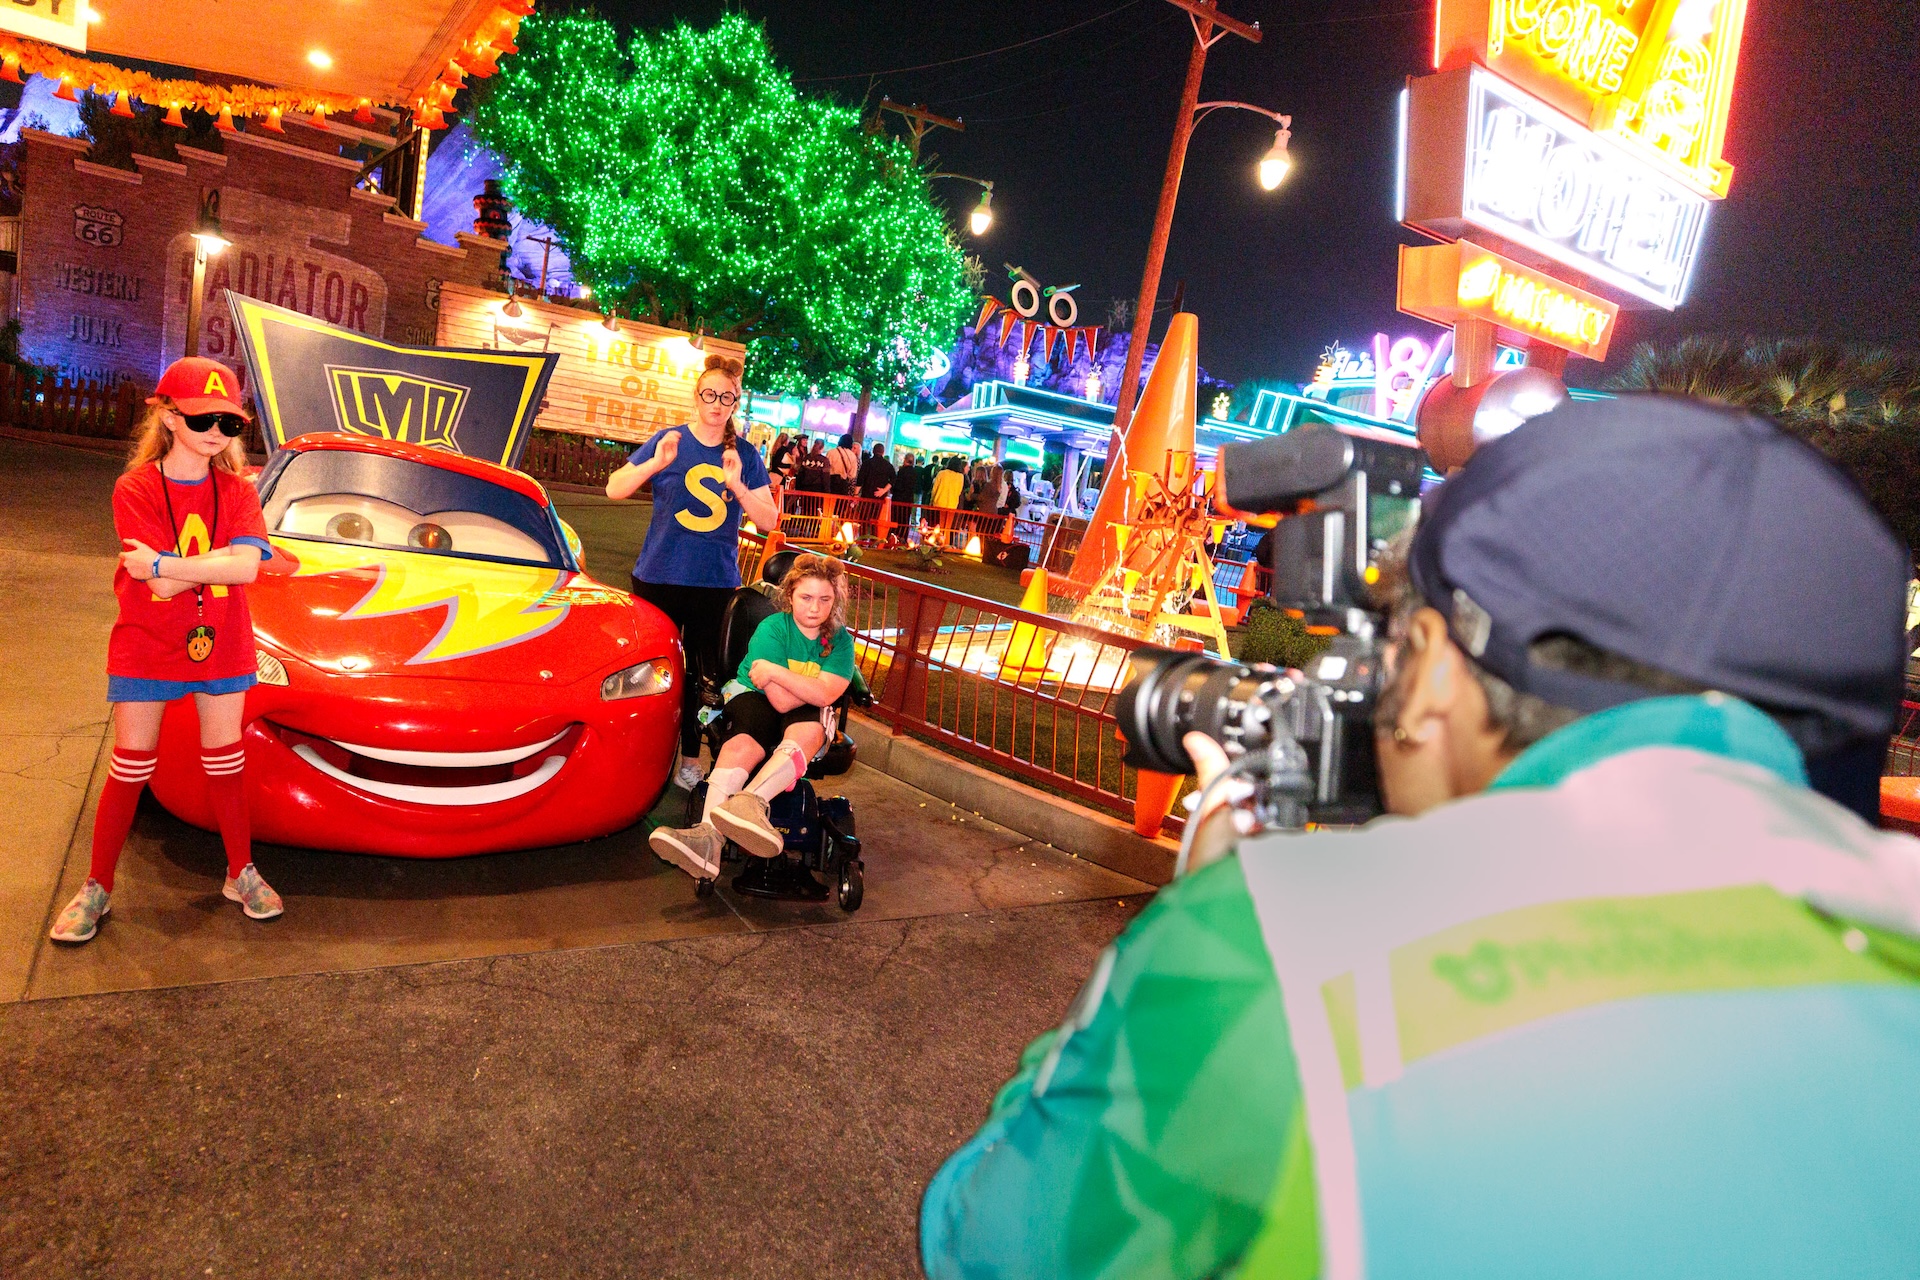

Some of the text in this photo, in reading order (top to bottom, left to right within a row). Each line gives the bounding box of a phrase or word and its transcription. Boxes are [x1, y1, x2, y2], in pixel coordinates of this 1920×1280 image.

[82, 208, 117, 223] ROUTE
[81, 223, 114, 245] 66
[54, 262, 141, 302] WESTERN
[66, 314, 122, 348] JUNK
[203, 371, 229, 397] A
[620, 375, 660, 401] OR
[582, 394, 692, 433] TREAT
[674, 463, 728, 532] S
[151, 513, 230, 602] A
